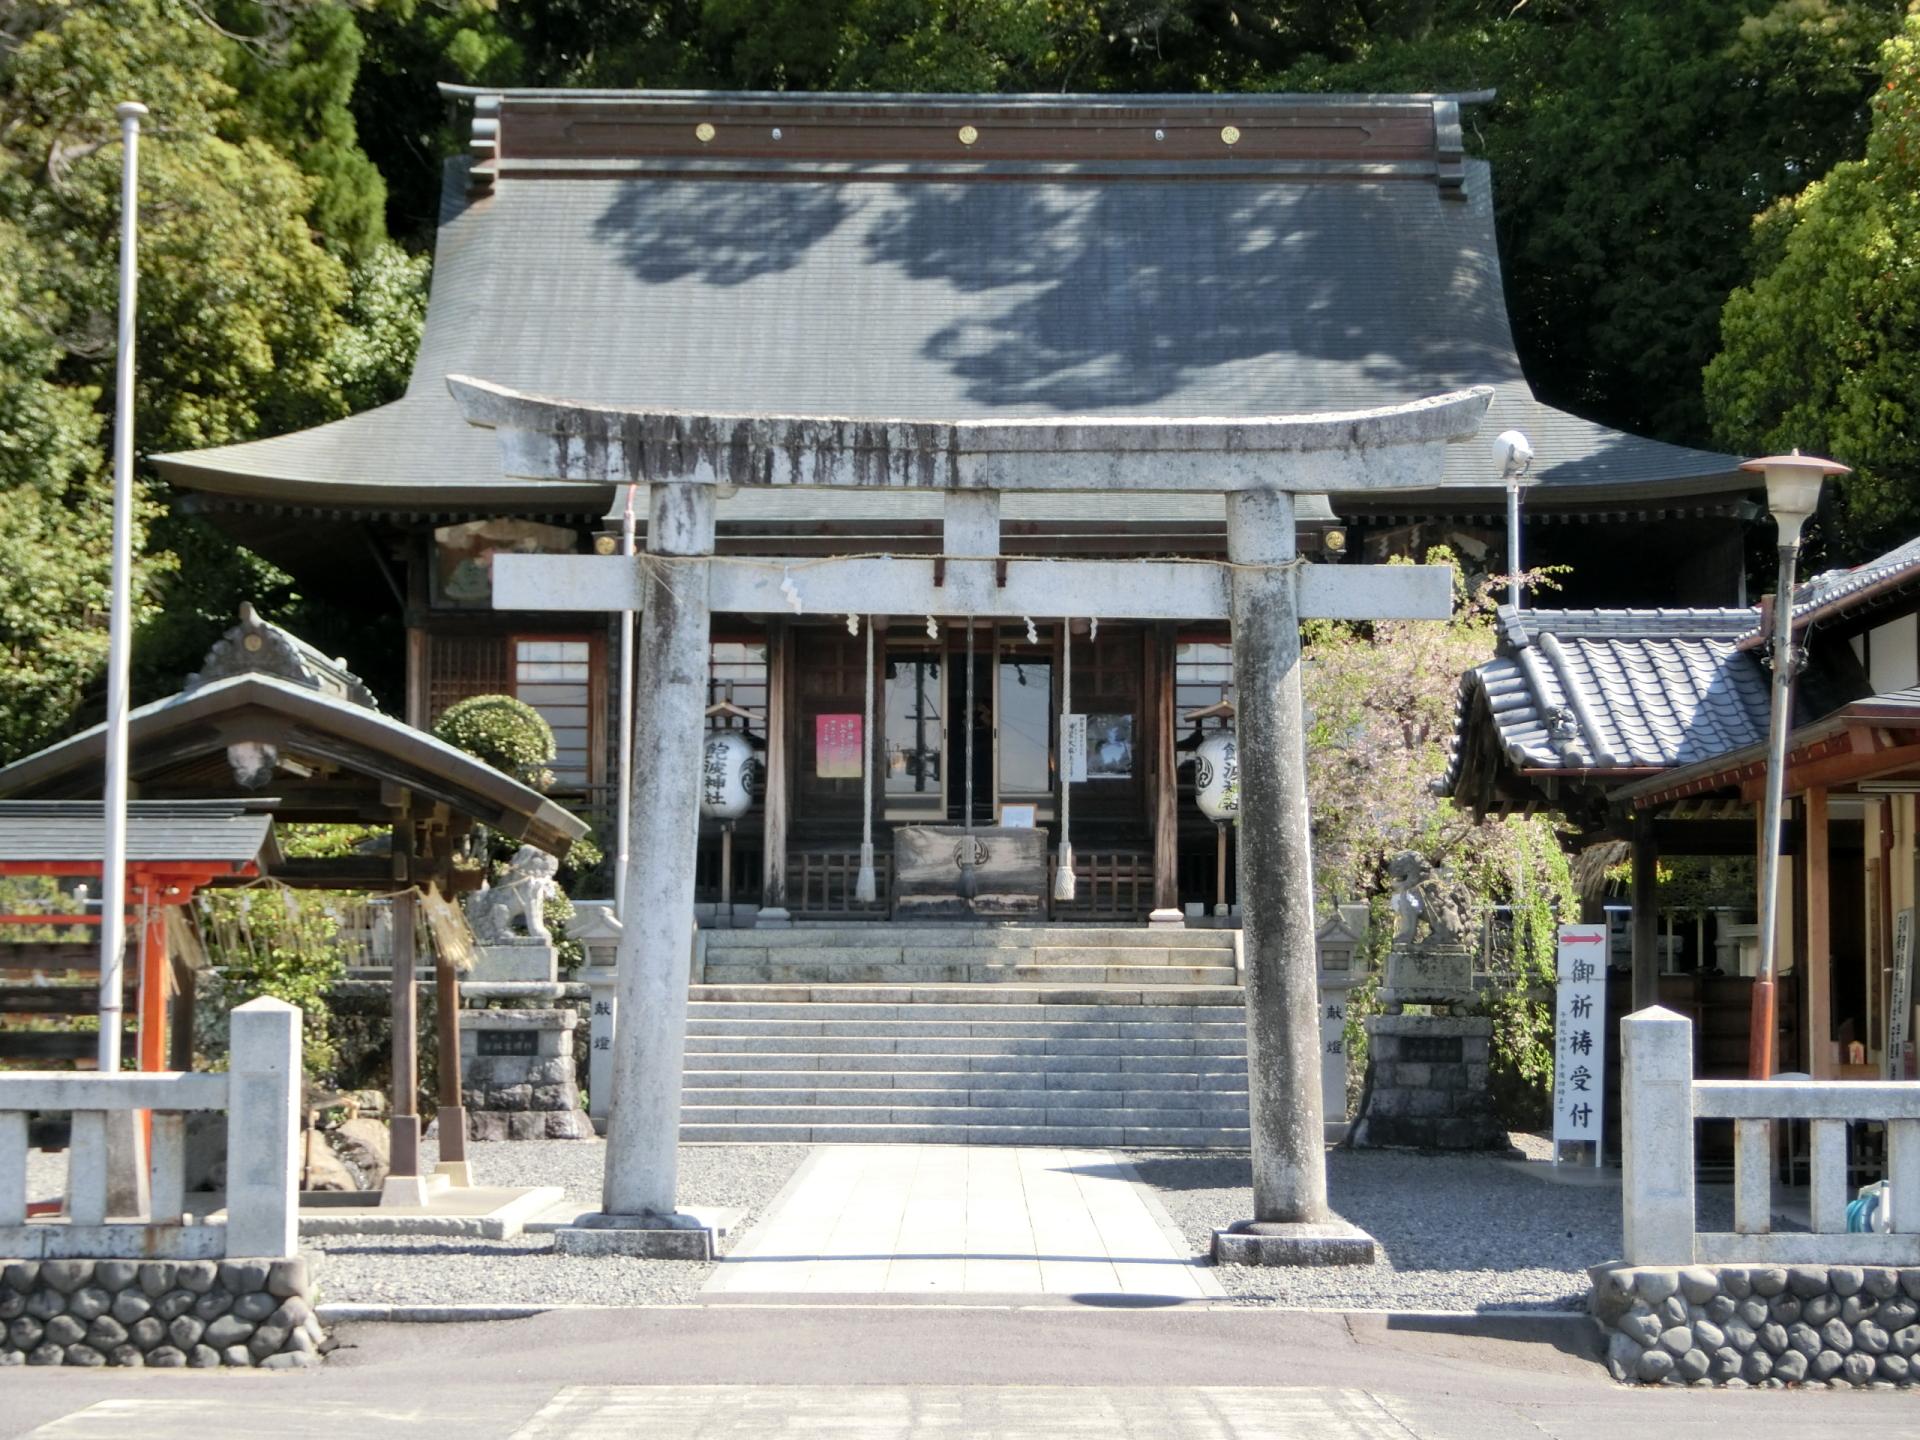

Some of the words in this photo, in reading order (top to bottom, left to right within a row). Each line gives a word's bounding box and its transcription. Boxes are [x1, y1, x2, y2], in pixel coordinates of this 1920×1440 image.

[704, 742, 729, 805] 飽波神社
[594, 1001, 611, 1050] 献燈
[1326, 1005, 1343, 1054] 献燈
[1569, 958, 1595, 1128] 御祈祷受付
